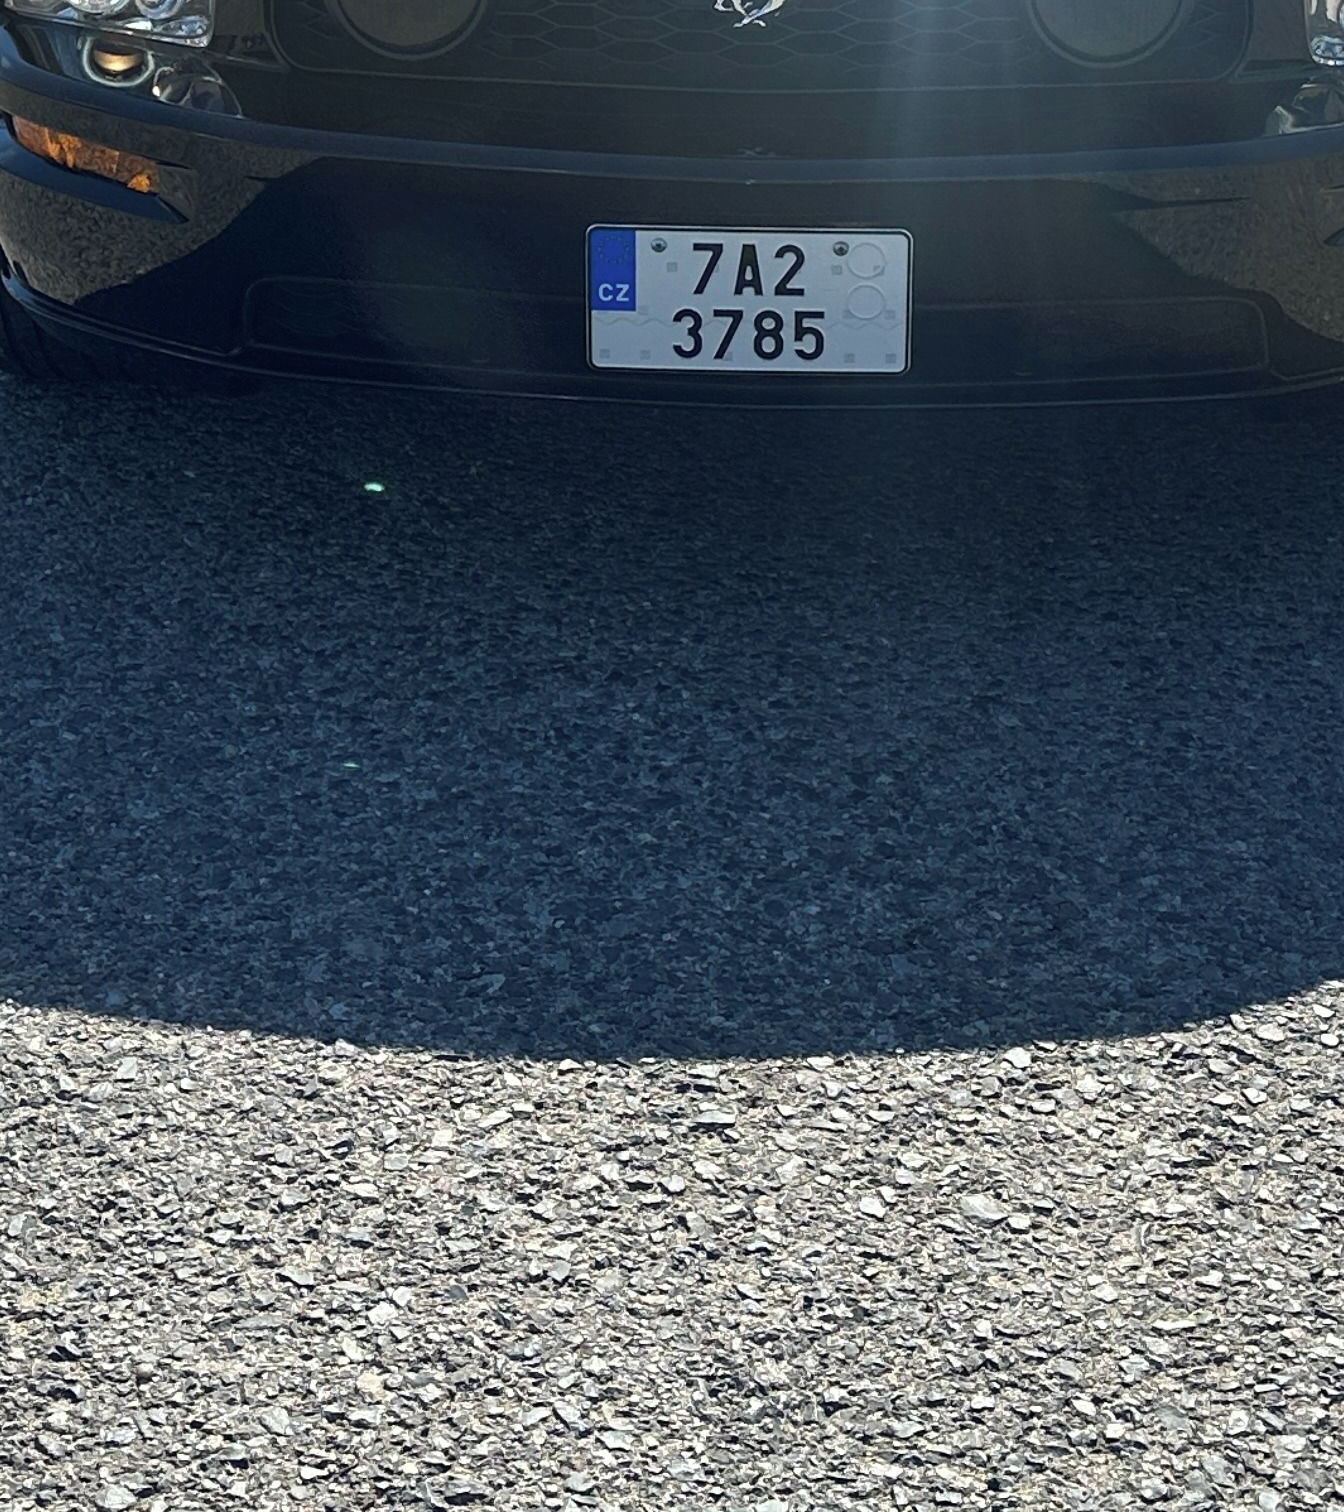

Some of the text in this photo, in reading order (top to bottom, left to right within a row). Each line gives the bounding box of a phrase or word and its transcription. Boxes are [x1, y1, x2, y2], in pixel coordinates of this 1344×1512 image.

[598, 283, 630, 303] CZ
[692, 243, 806, 297] 7A2
[672, 308, 826, 361] 3785
